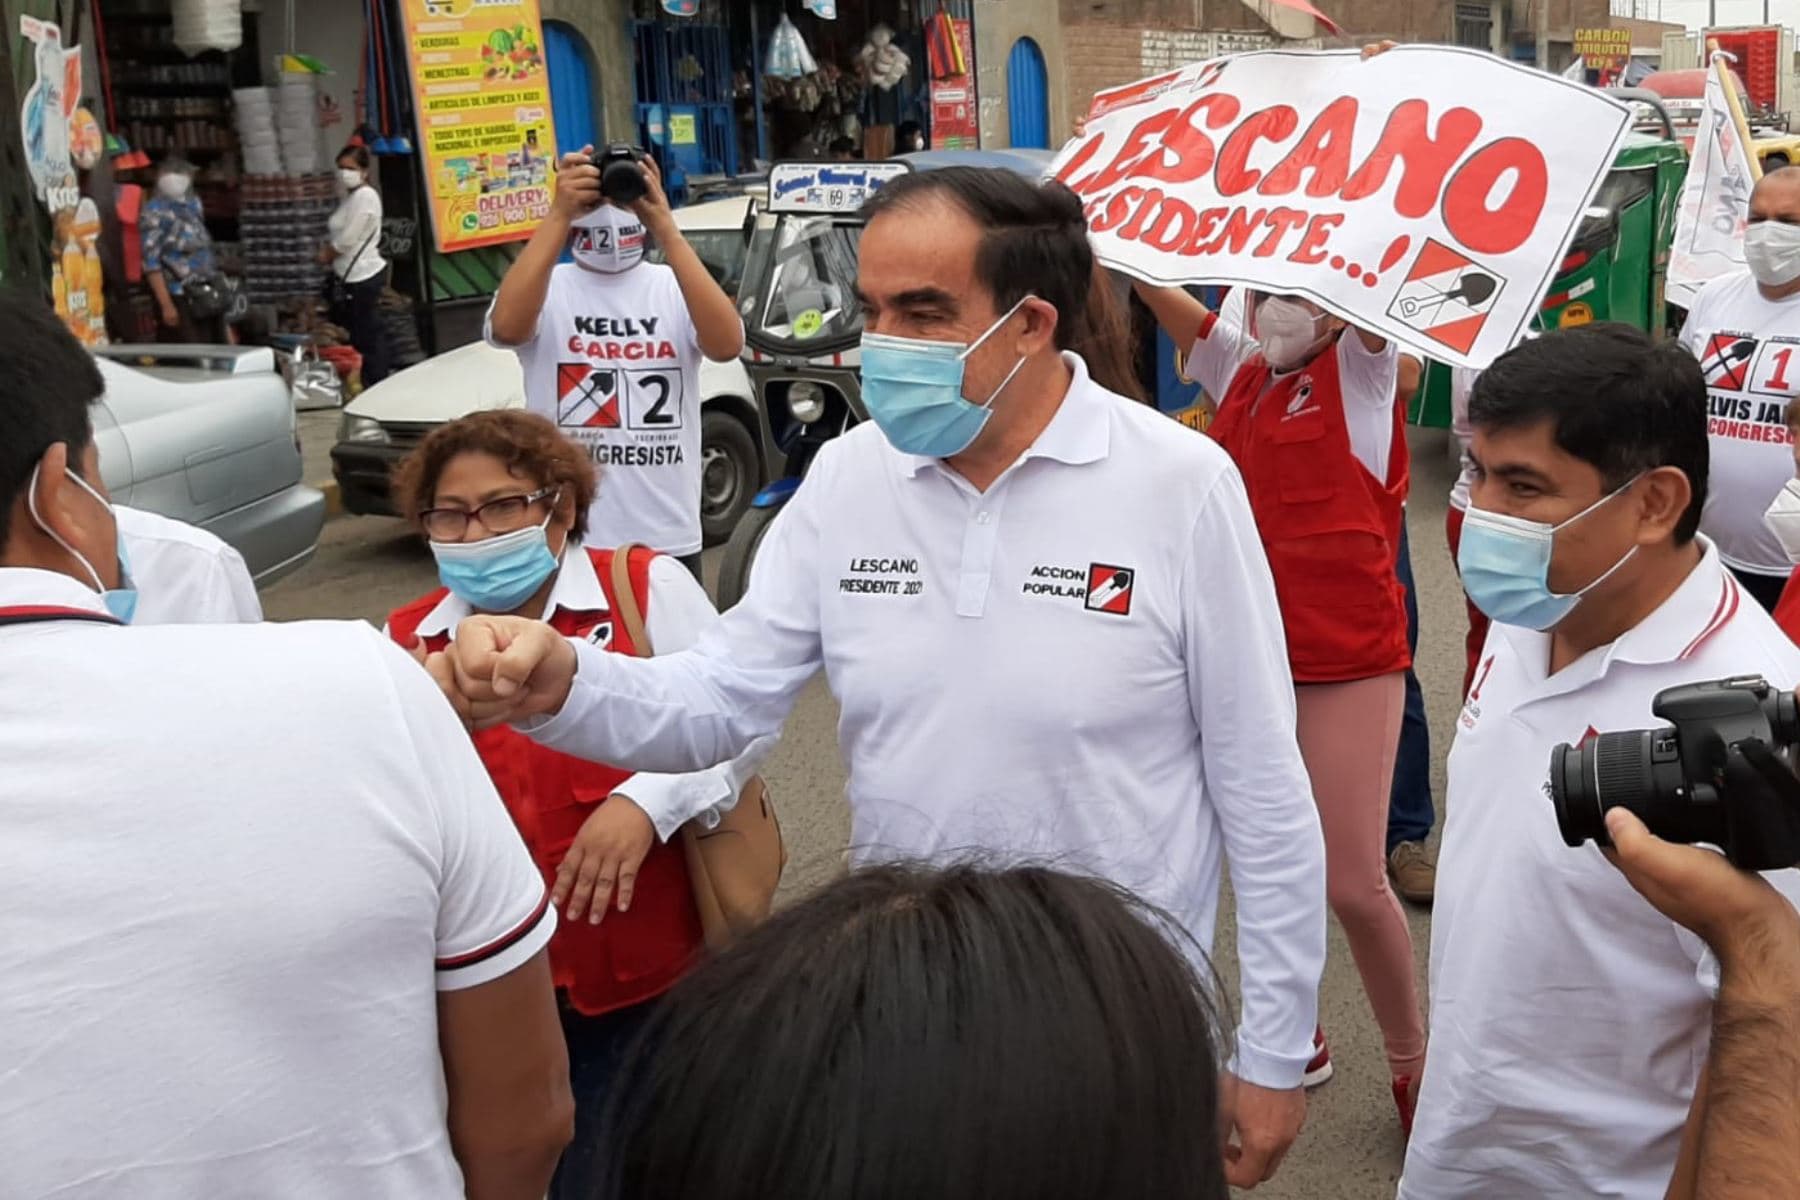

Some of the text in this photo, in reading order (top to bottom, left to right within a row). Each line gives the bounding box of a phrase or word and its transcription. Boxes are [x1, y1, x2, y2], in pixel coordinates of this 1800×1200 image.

[424, 67, 470, 79] MENESTRAS
[1055, 93, 1549, 255] LESCANO
[829, 189, 844, 206] 69
[598, 229, 609, 248] 2
[1084, 185, 1410, 287] ESIDENTE...!
[574, 315, 659, 337] KELLY
[568, 335, 677, 361] GARCIA
[1764, 348, 1793, 390] 1
[637, 374, 674, 424] 2
[1755, 402, 1786, 426] JA
[850, 558, 919, 574] LESCANO
[1031, 565, 1086, 581] ACCION
[839, 578, 900, 595] PRESIDENTE
[1023, 582, 1086, 600] POPULAR
